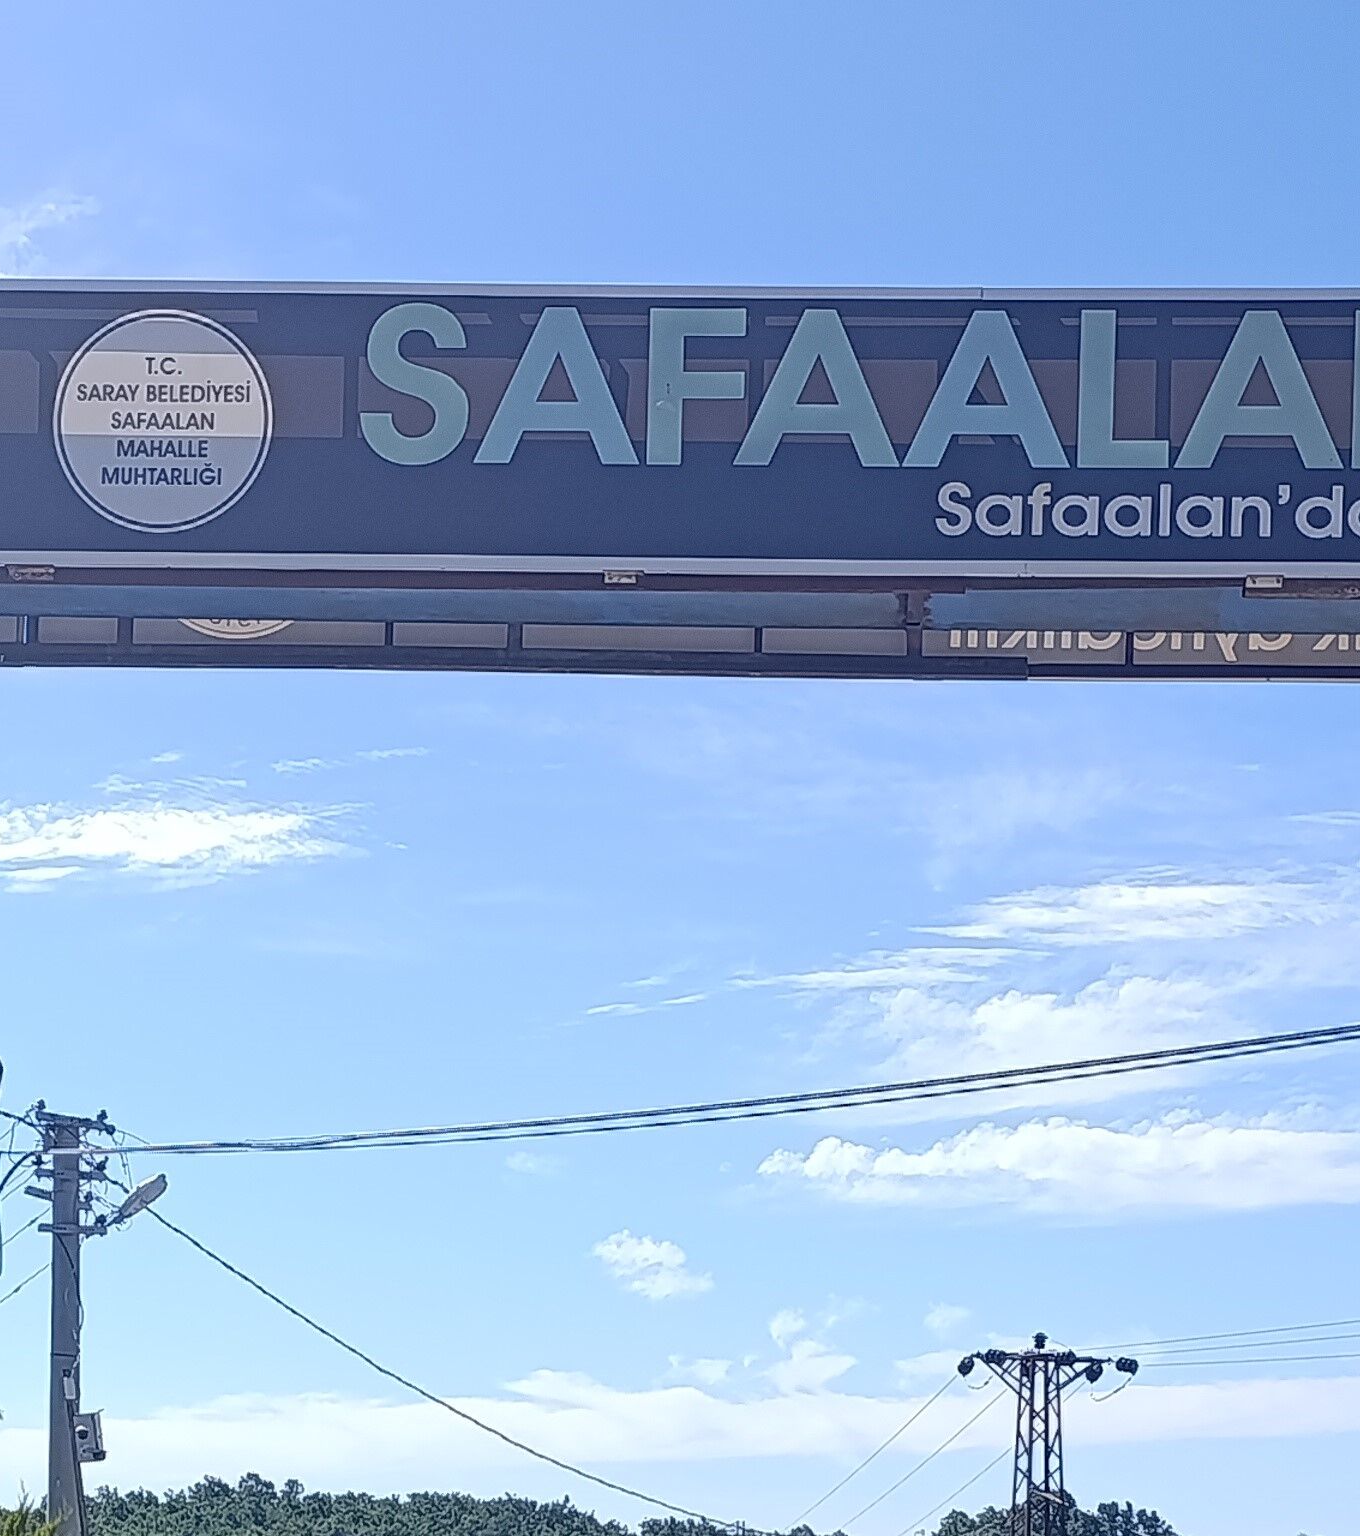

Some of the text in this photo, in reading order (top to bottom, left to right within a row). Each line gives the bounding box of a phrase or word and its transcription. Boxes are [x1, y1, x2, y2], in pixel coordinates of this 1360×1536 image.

[144, 356, 183, 375] T.C.
[76, 380, 252, 403] SARAY BELEDİYESİ
[110, 411, 216, 431] SAFAALAN
[116, 439, 209, 459] MAHALLE
[100, 463, 223, 486] MUHTARLIĞI
